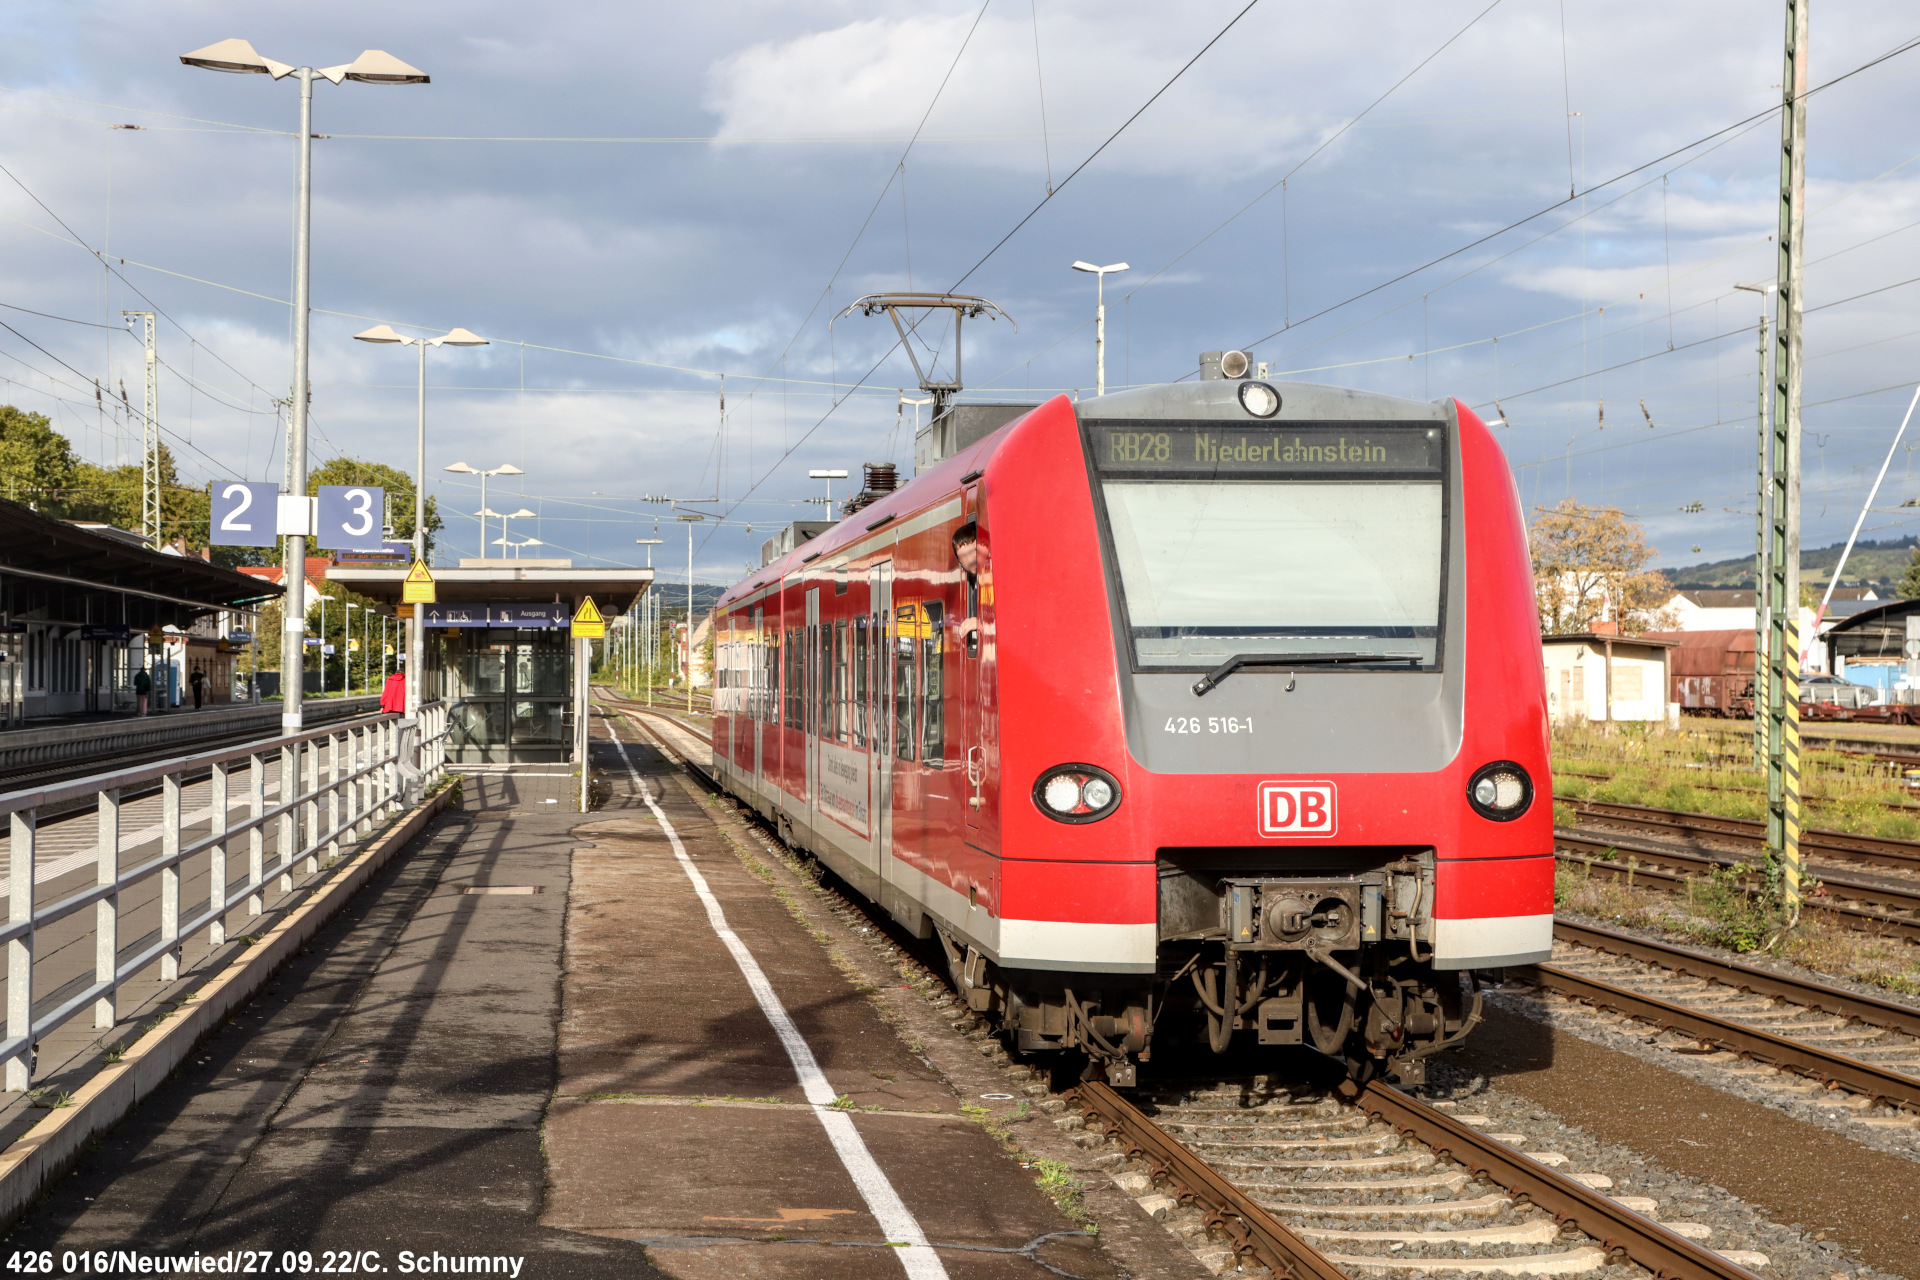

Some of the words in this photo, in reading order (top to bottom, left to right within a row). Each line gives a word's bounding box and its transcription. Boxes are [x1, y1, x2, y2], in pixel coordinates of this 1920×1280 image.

[1110, 433, 1170, 461] RB28
[1195, 433, 1387, 462] Niederlahnstein
[221, 484, 252, 531] 2
[342, 488, 373, 536] 3
[0, 611, 8, 627] 1
[520, 610, 547, 618] Ausgang
[1164, 716, 1201, 735] 426
[1207, 716, 1254, 735] 516-1
[1269, 790, 1328, 829] DB
